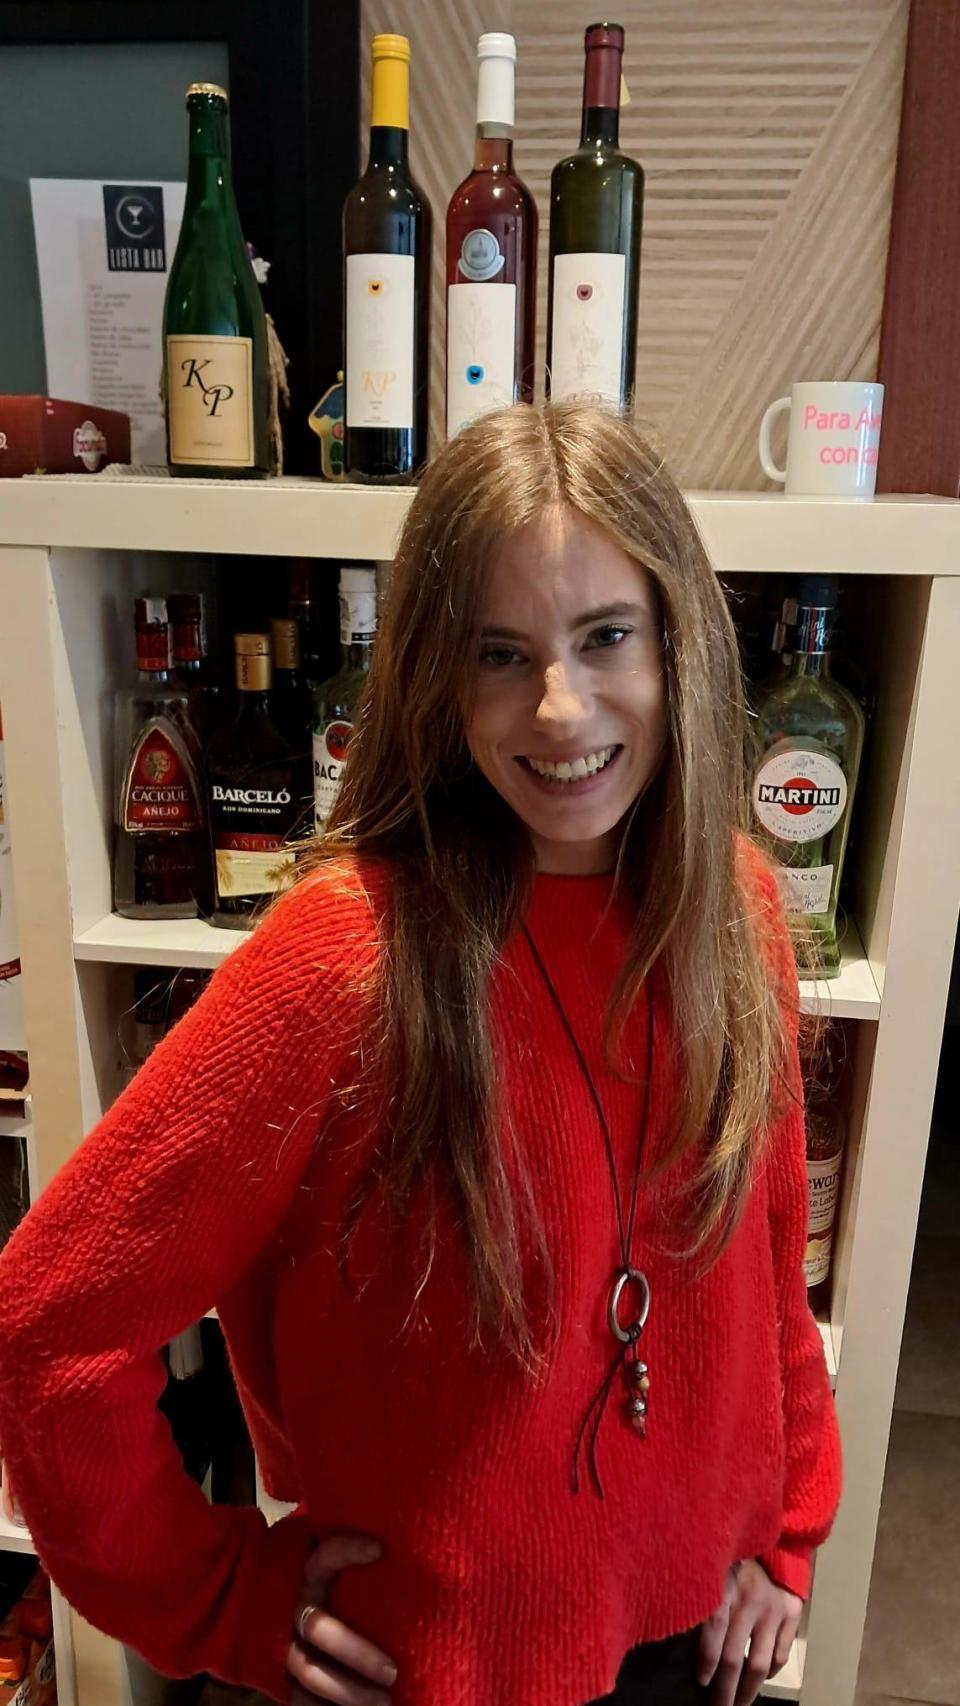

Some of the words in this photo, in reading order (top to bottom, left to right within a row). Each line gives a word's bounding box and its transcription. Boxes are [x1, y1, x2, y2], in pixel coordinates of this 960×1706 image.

[804, 405, 851, 430] Para
[820, 447, 859, 465] con
[314, 761, 341, 781] BAC
[131, 790, 189, 802] CACIQUE
[212, 785, 291, 804] BARCELÓ
[761, 786, 838, 805] MARTINI
[143, 804, 180, 816] AÑEJO
[238, 806, 281, 814] DOMINICANO
